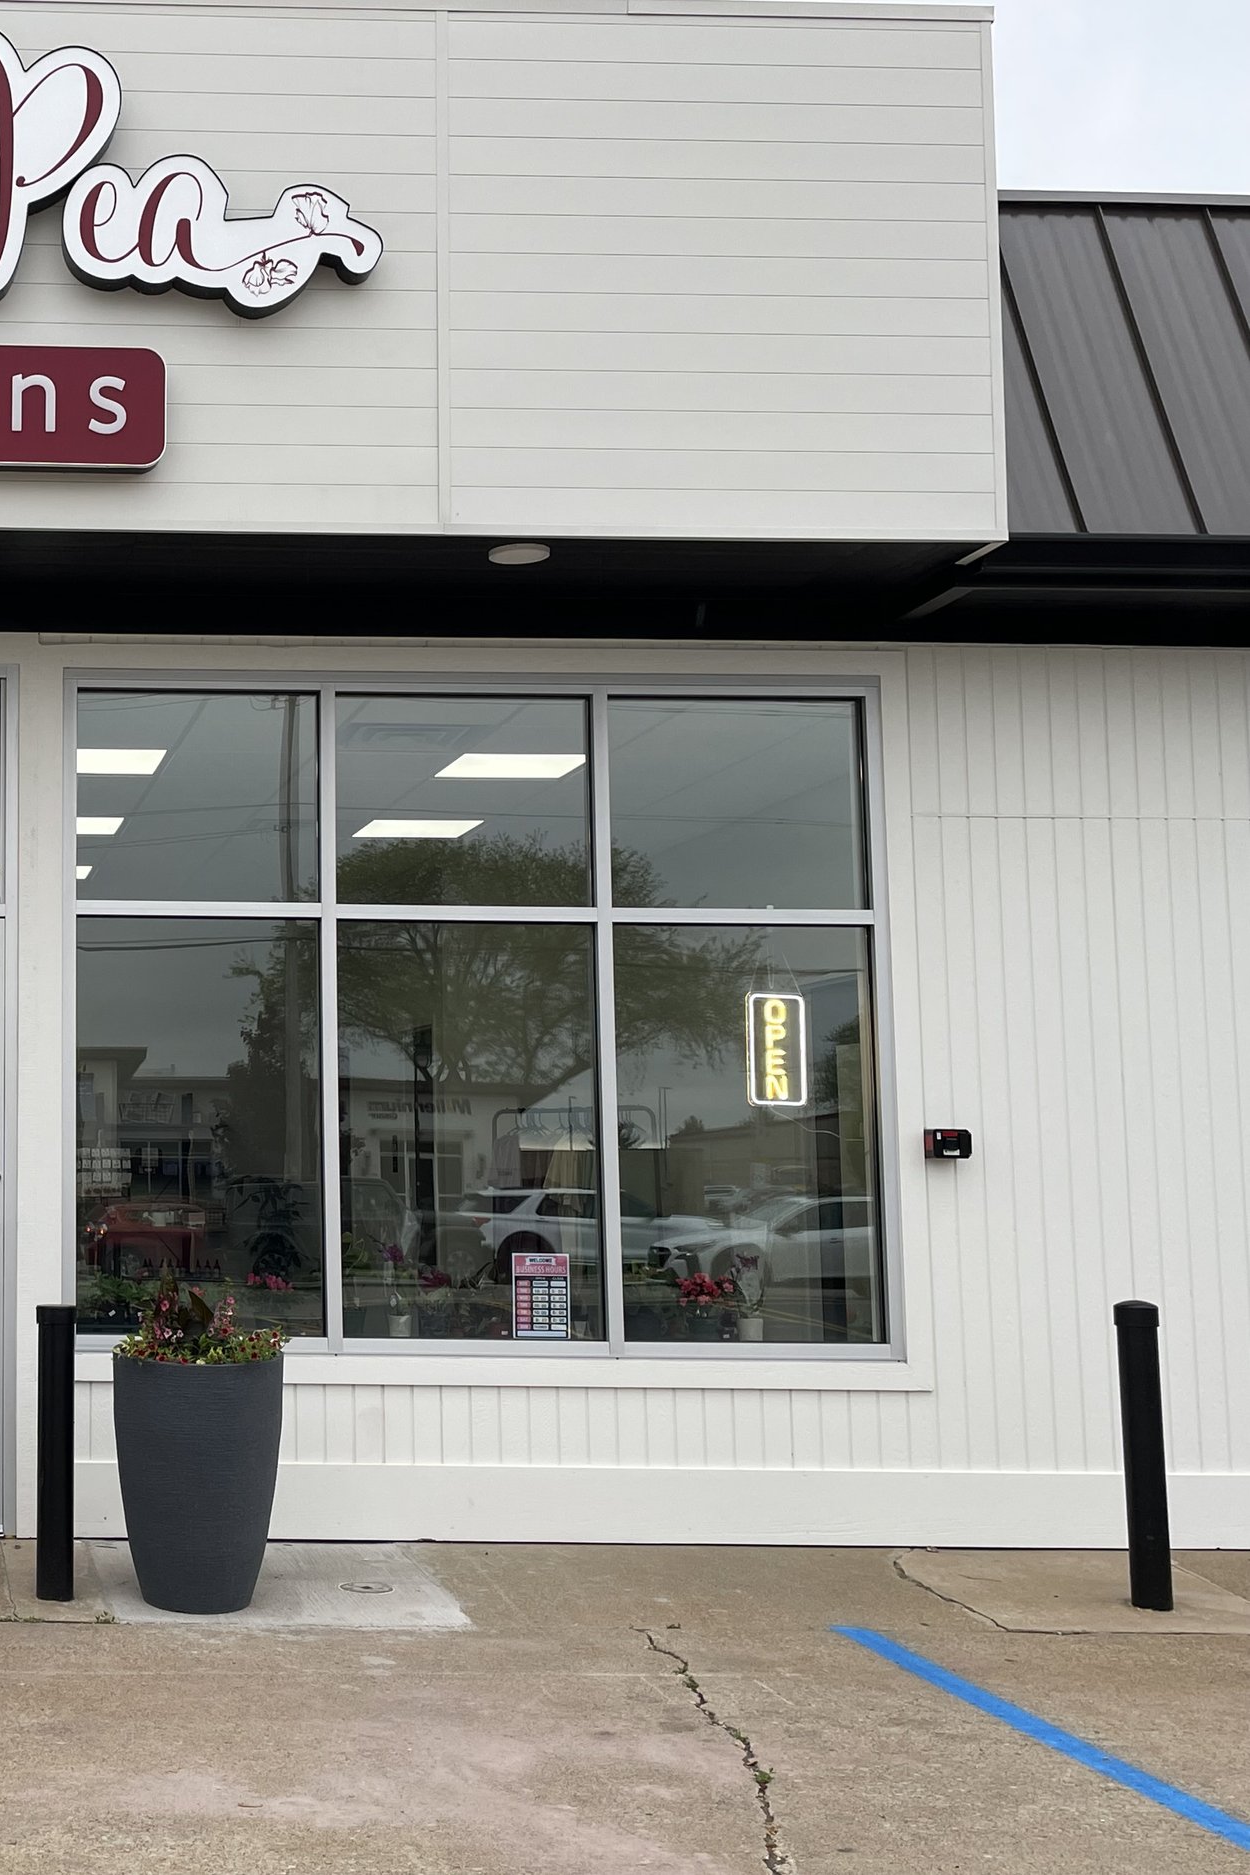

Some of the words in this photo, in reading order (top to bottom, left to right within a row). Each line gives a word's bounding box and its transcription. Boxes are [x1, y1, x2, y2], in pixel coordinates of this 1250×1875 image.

[763, 998, 789, 1101] OPEN
[516, 1266, 545, 1274] BUSINESS
[545, 1266, 566, 1274] HOURS
